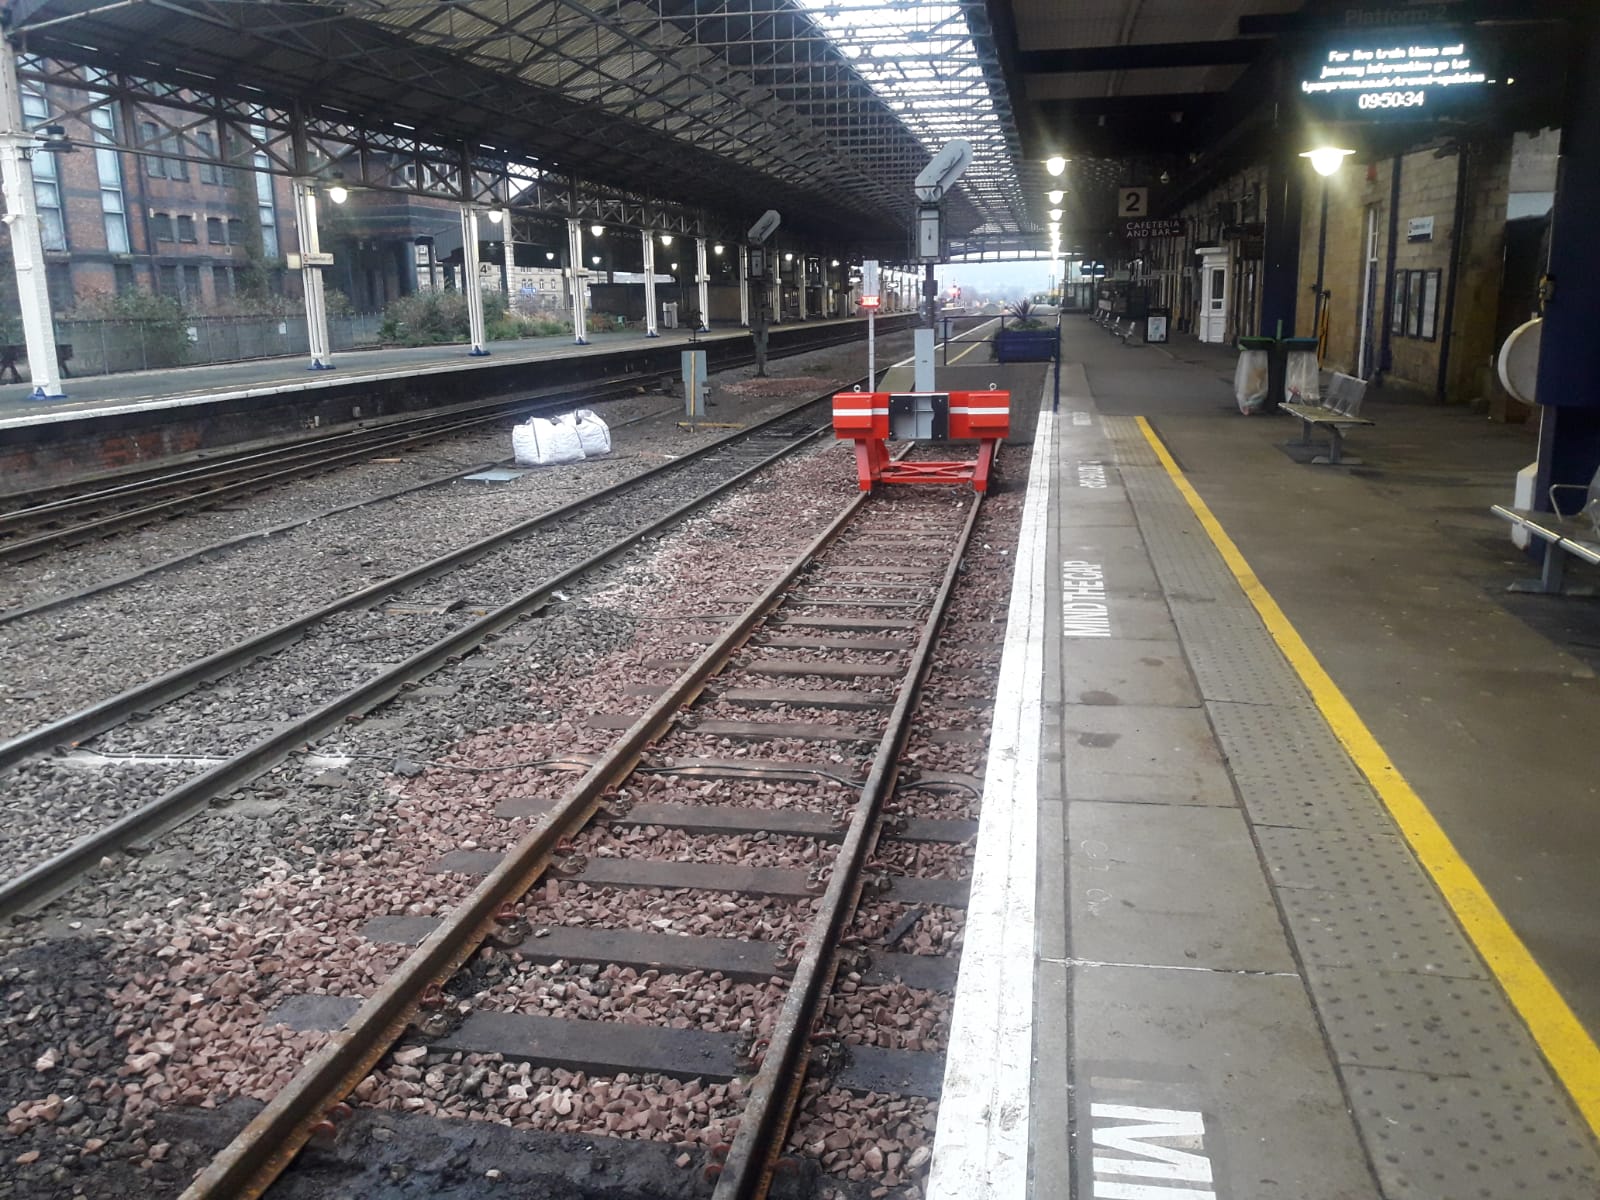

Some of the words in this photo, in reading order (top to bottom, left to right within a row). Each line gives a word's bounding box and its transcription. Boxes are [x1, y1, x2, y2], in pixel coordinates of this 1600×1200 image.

[1344, 8, 1429, 25] Platform
[1328, 51, 1350, 62] For
[1441, 44, 1464, 56] and
[1358, 91, 1425, 109] 09:50:34
[1126, 192, 1140, 212] 2
[1126, 220, 1179, 230] CAFETERIA
[1126, 229, 1149, 238] AND
[1151, 228, 1171, 237] BAR
[1063, 560, 1104, 580] GAP
[1063, 581, 1106, 602] THE
[1063, 602, 1111, 637] MIND
